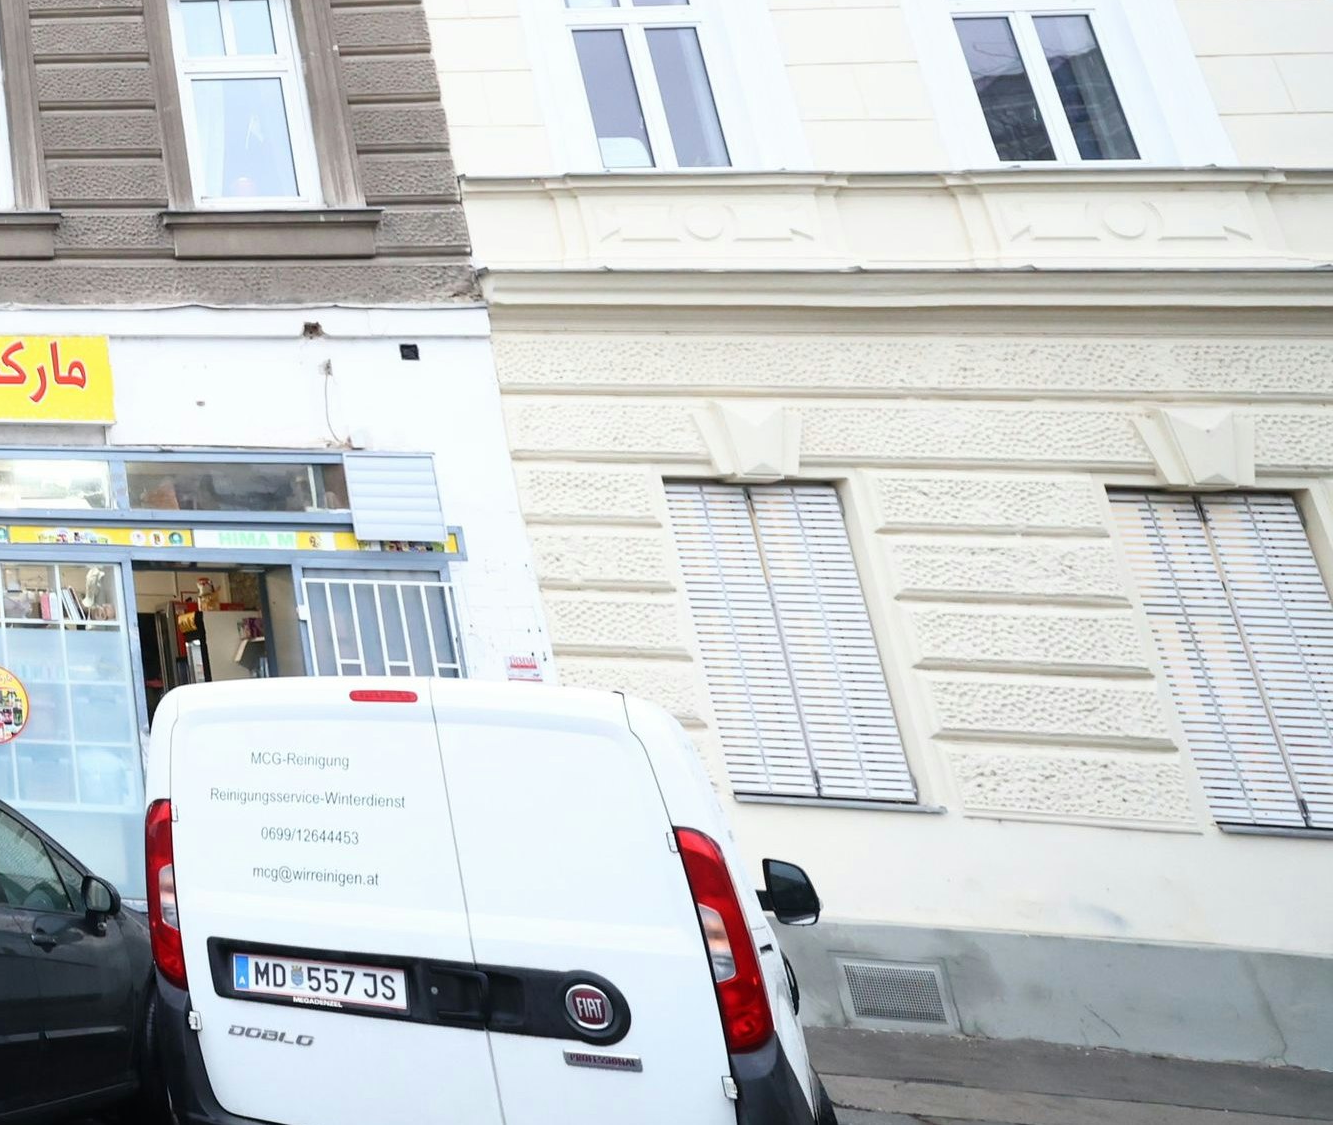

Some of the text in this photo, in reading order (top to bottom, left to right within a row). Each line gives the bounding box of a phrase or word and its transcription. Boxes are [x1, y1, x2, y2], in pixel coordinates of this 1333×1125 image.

[250, 751, 350, 771] MCG-Reinigung
[210, 787, 406, 809] Reinigungsservice-Winterdienst
[260, 826, 359, 845] 0699/12644453
[252, 865, 379, 887] mcg@wirreinigen.at
[254, 961, 286, 987] MD
[306, 966, 355, 996] 557
[363, 972, 396, 1001] JS
[293, 996, 343, 1008] MEGADENZEL
[575, 997, 602, 1019] FIAT
